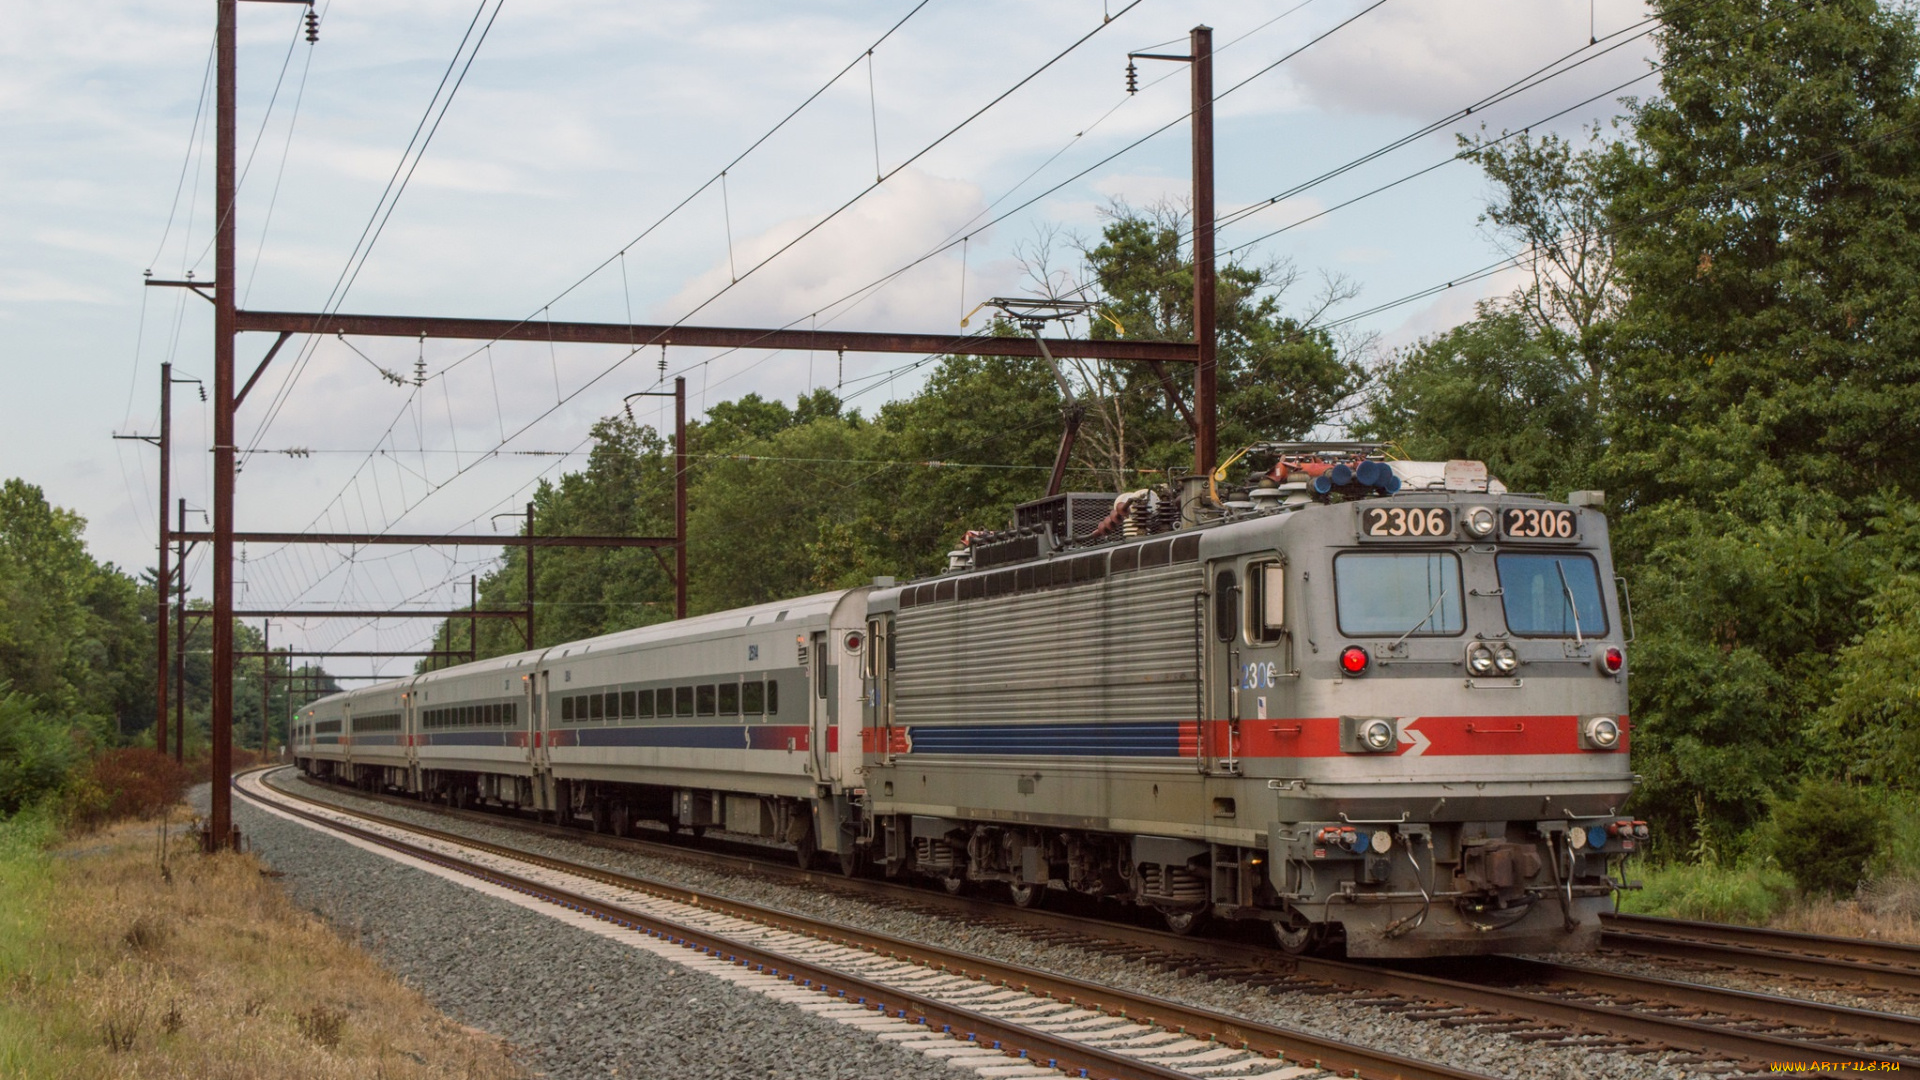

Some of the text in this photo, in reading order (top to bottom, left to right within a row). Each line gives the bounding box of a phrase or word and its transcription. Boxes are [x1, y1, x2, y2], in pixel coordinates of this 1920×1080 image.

[1370, 508, 1445, 536] 2306
[1509, 509, 1572, 538] 2306
[1242, 661, 1275, 689] 2306
